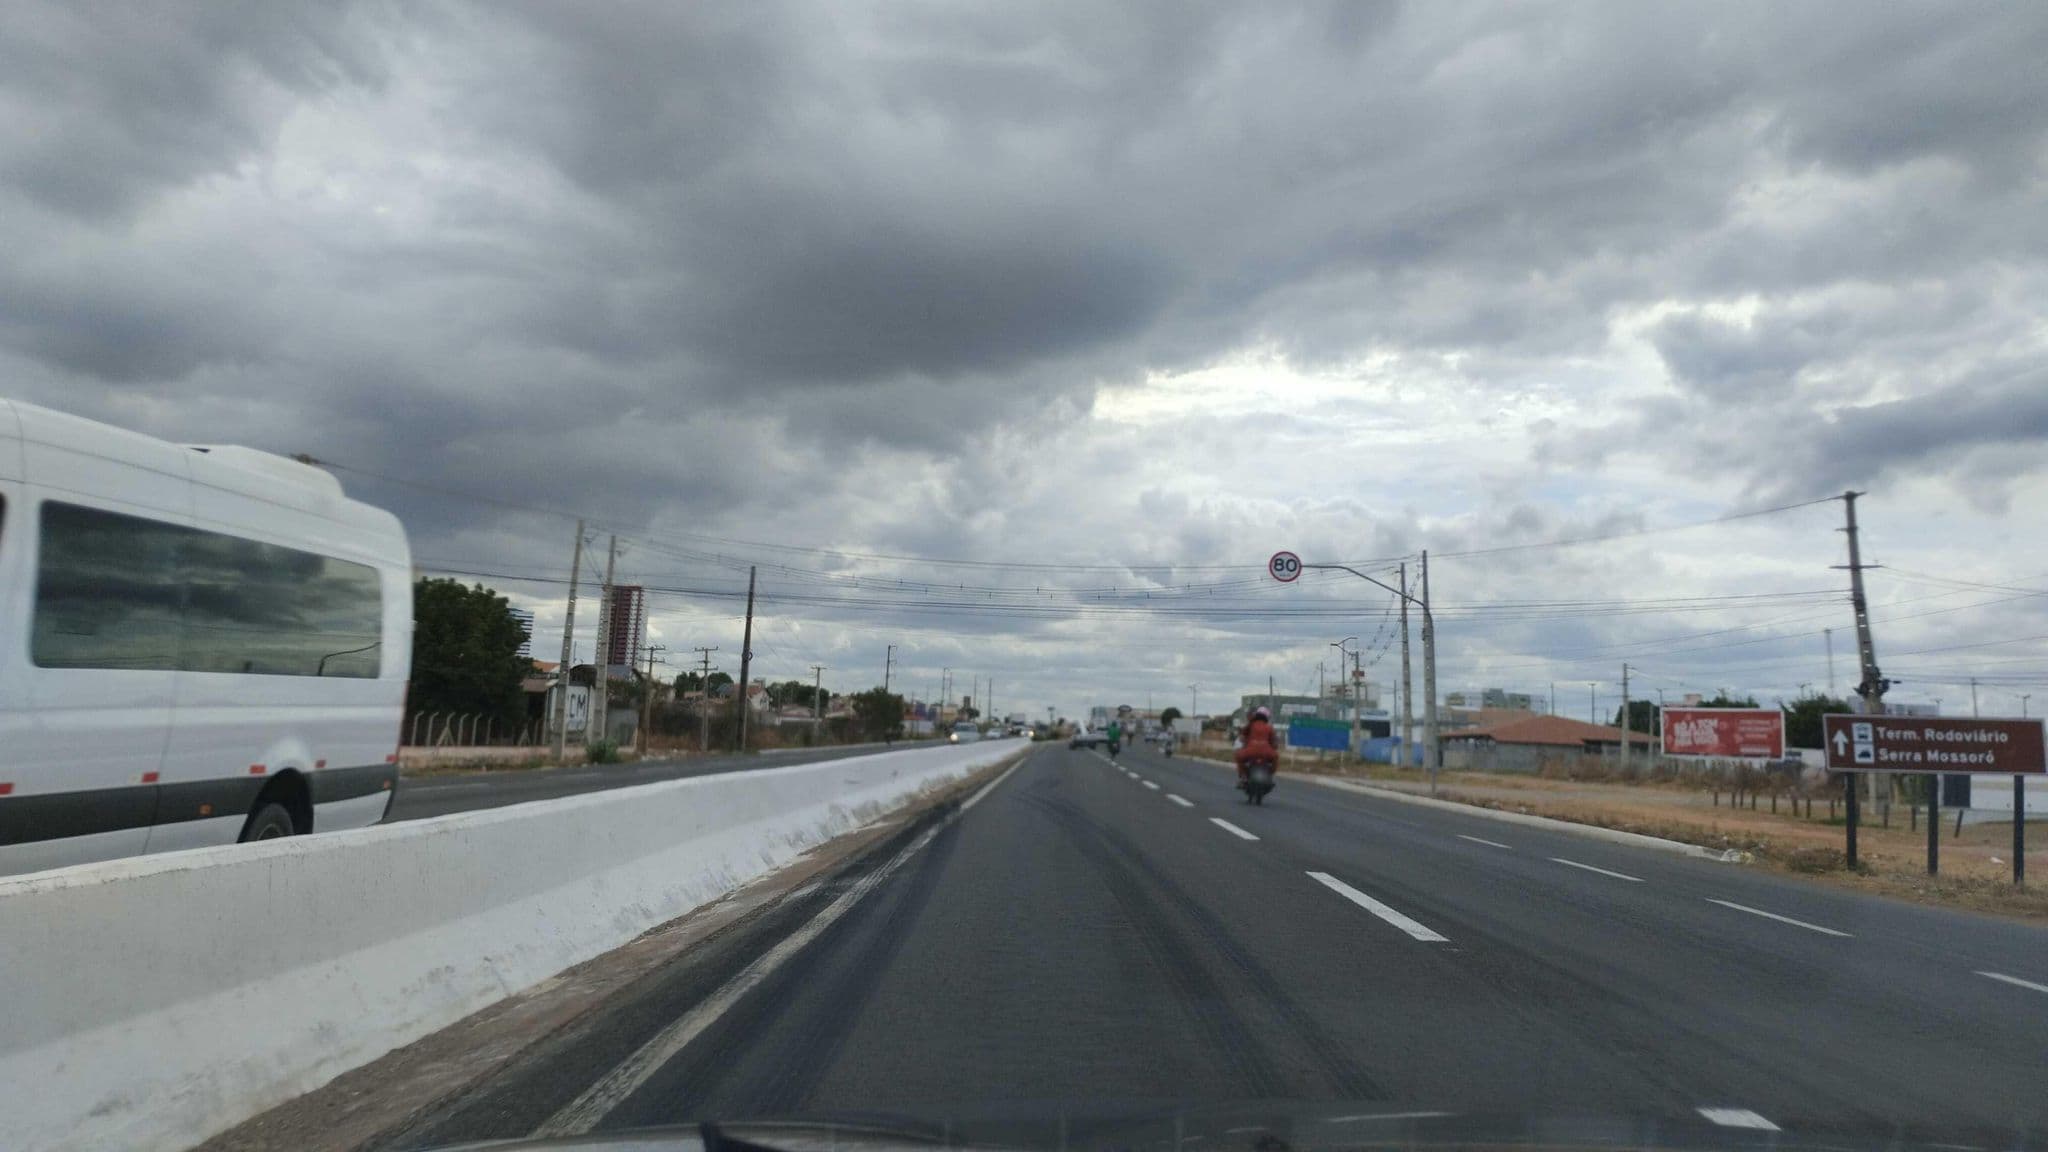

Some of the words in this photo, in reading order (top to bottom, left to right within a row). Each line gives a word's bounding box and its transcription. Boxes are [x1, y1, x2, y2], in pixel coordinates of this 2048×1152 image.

[1274, 558, 1297, 572] 80
[1876, 726, 1920, 740] Term.
[1924, 728, 2009, 743] Rodoviário
[1879, 748, 1922, 761] Serra
[1927, 749, 1995, 764] Mossoró
